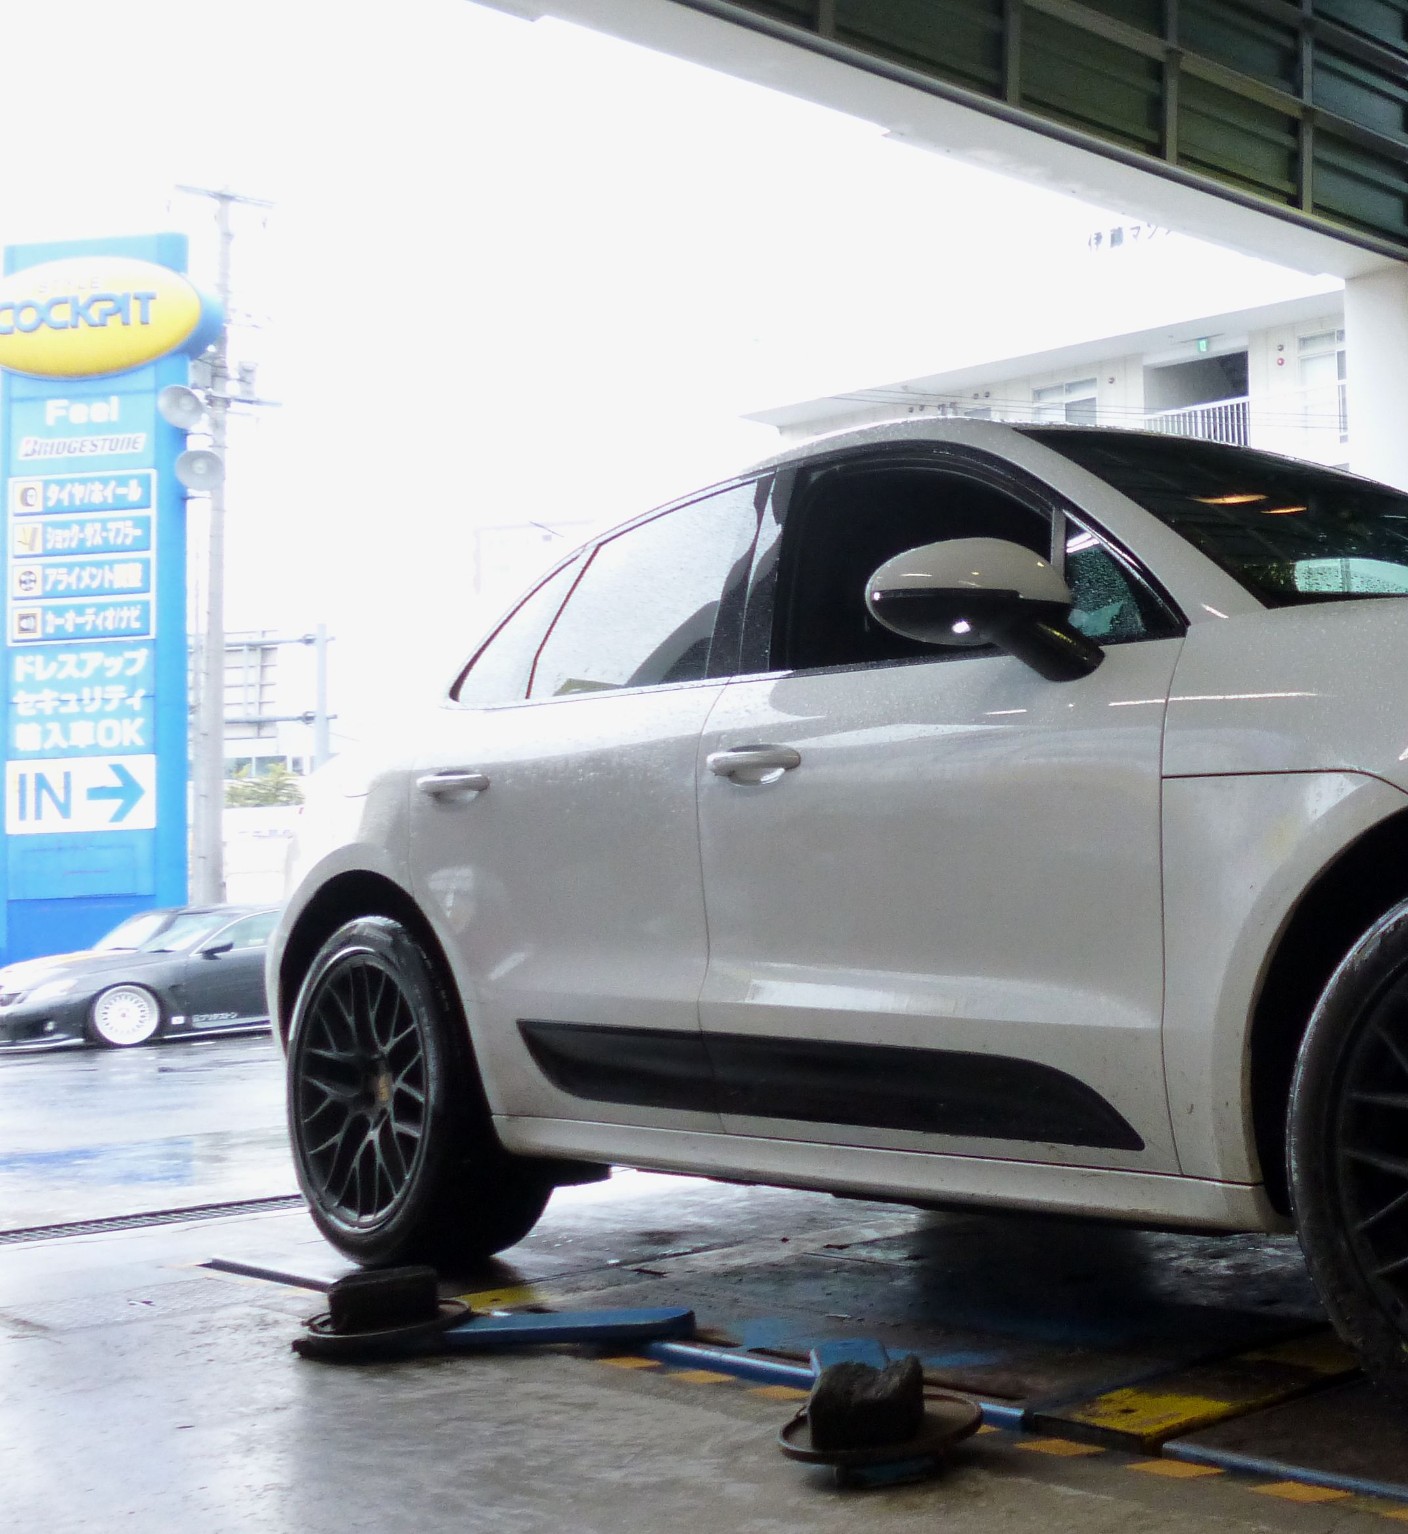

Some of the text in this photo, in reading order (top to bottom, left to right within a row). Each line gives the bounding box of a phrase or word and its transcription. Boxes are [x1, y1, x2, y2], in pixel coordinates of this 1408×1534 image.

[22, 435, 145, 457] BRIDGESTONE
[15, 648, 149, 682] ドレスアップ
[13, 685, 146, 716] セキュリティ
[18, 771, 72, 821] IN
